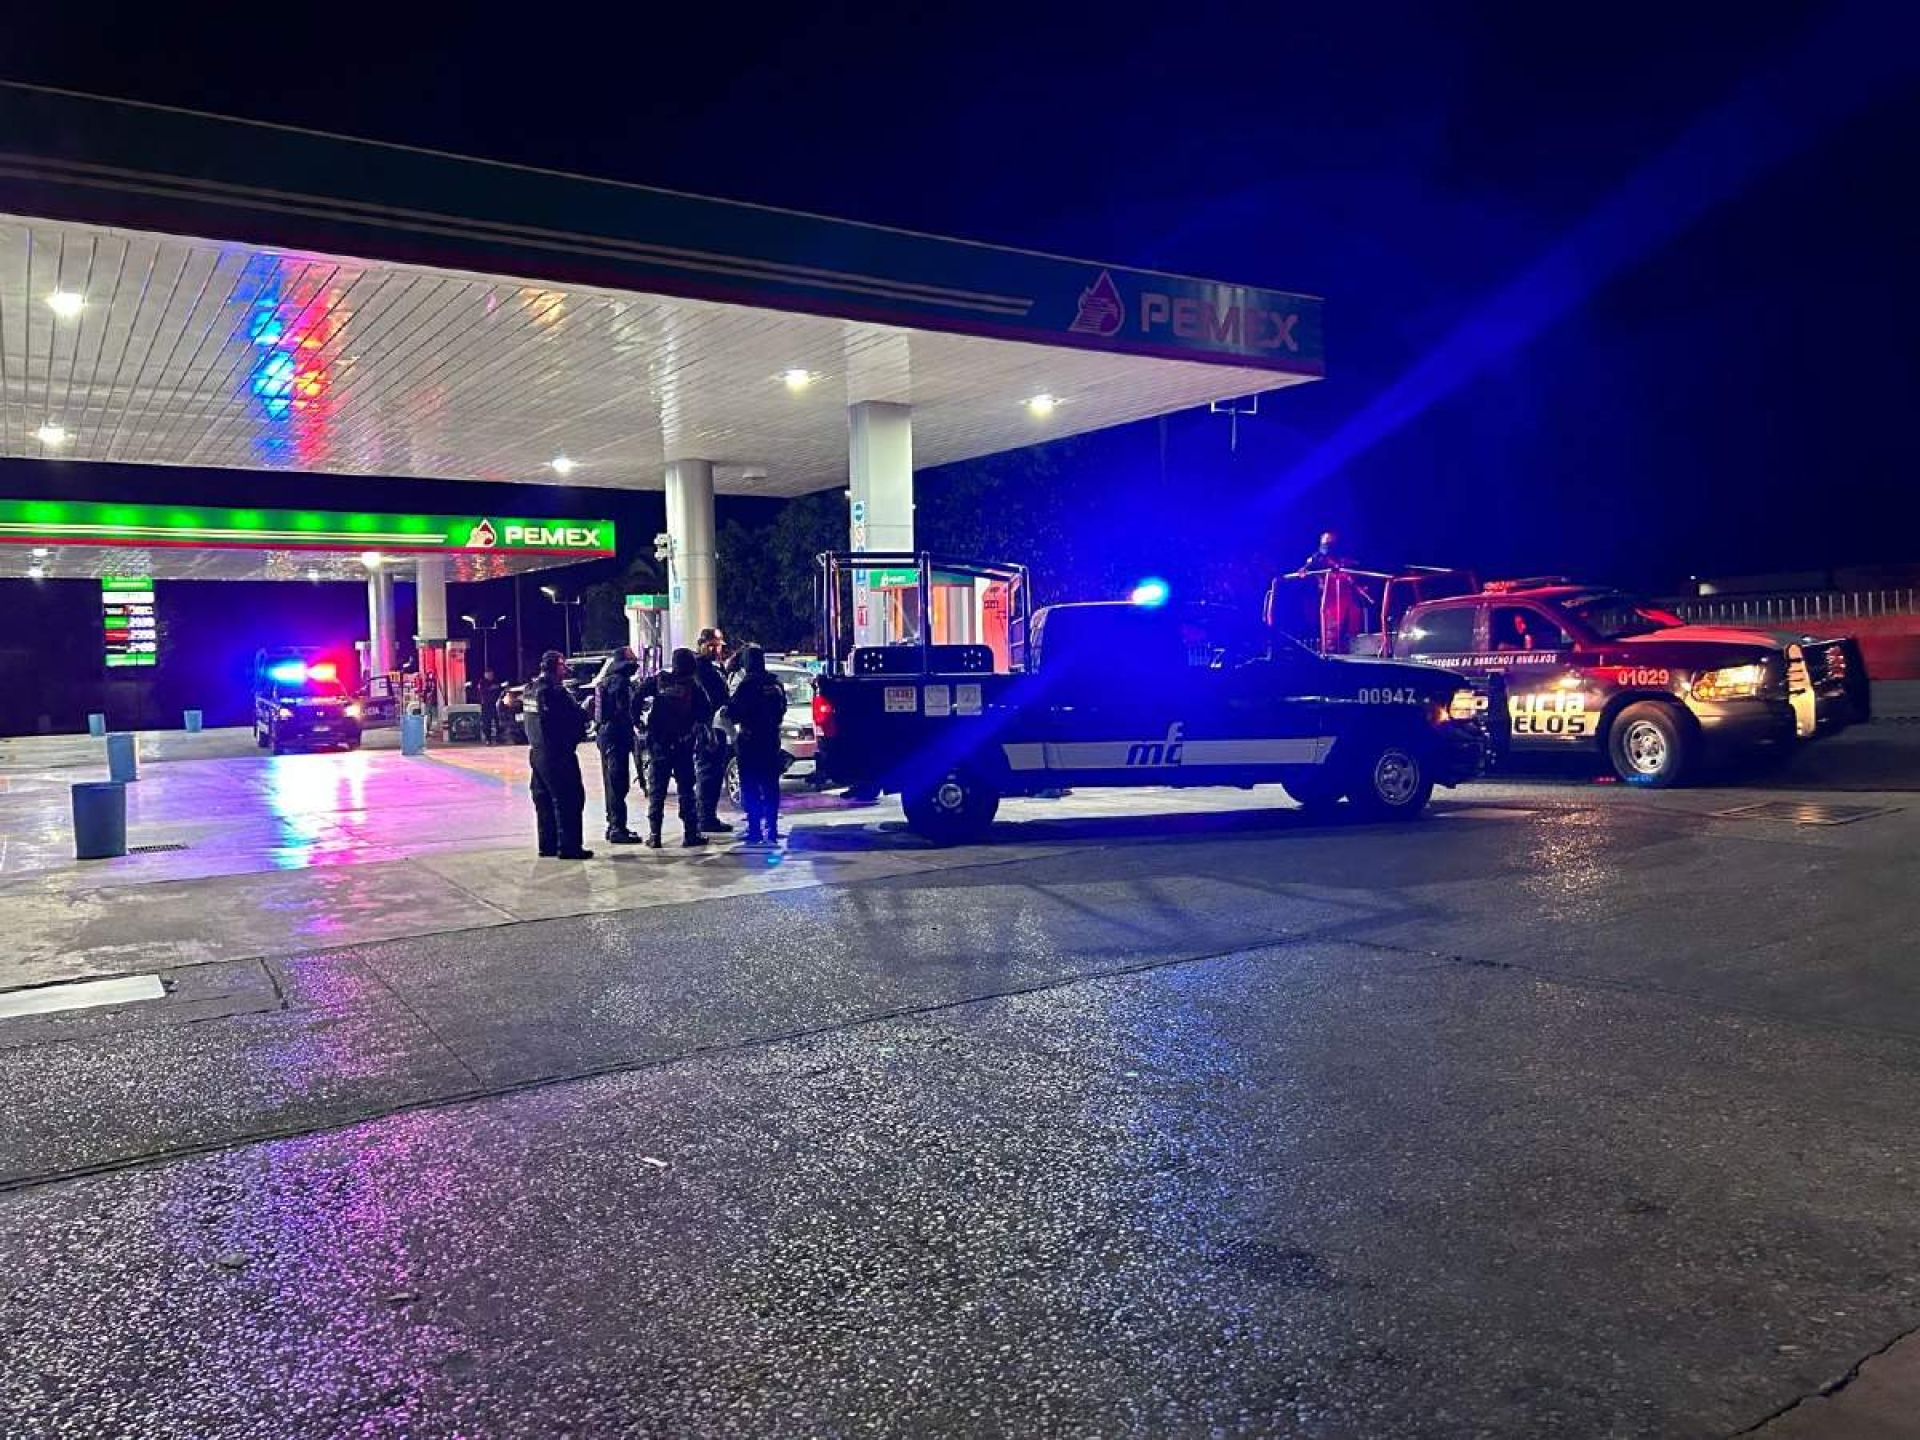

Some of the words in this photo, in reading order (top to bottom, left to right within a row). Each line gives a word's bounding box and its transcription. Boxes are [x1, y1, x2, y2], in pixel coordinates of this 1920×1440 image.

[1140, 293, 1299, 350] PEMEX
[504, 526, 601, 547] PEMEX
[1618, 668, 1670, 686] 01029
[1358, 688, 1416, 705] 00947
[1514, 714, 1586, 734] ELOS
